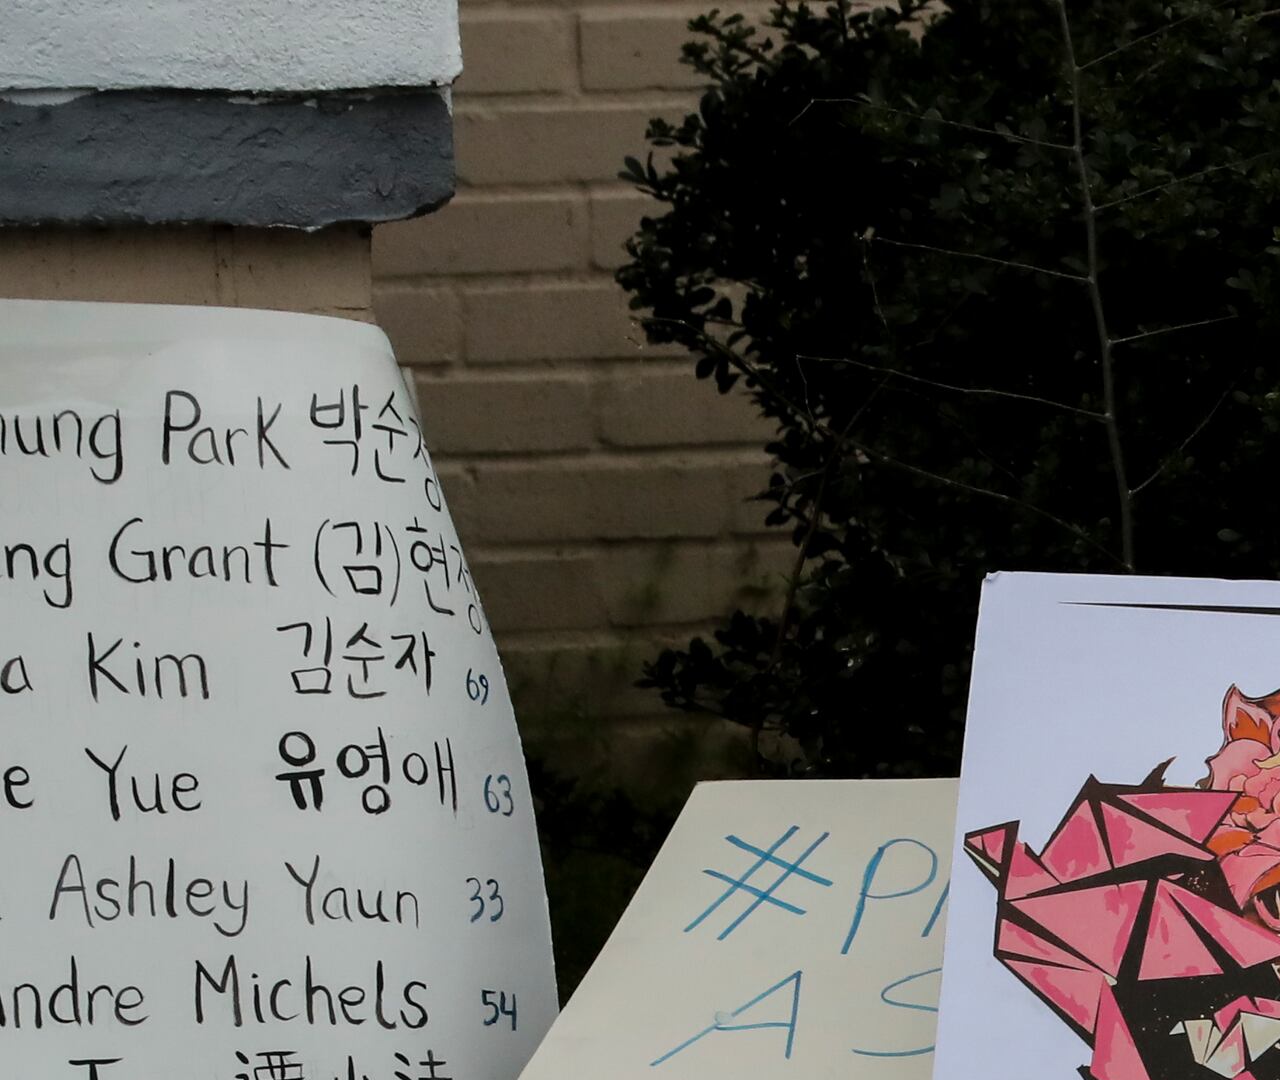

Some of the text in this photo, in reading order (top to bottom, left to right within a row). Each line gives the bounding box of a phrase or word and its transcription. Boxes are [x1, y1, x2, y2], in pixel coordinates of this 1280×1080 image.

[161, 390, 292, 471] Park
[108, 518, 290, 586] Grant
[86, 632, 210, 703] Kim
[276, 617, 436, 700] 김순자
[465, 668, 490, 705] 69
[85, 745, 203, 822] Yue
[275, 727, 459, 815] 유영애
[483, 774, 515, 816] 63
[49, 854, 504, 937] Ashley Yaun 33
[0, 954, 518, 1031] ndre Michels 54
